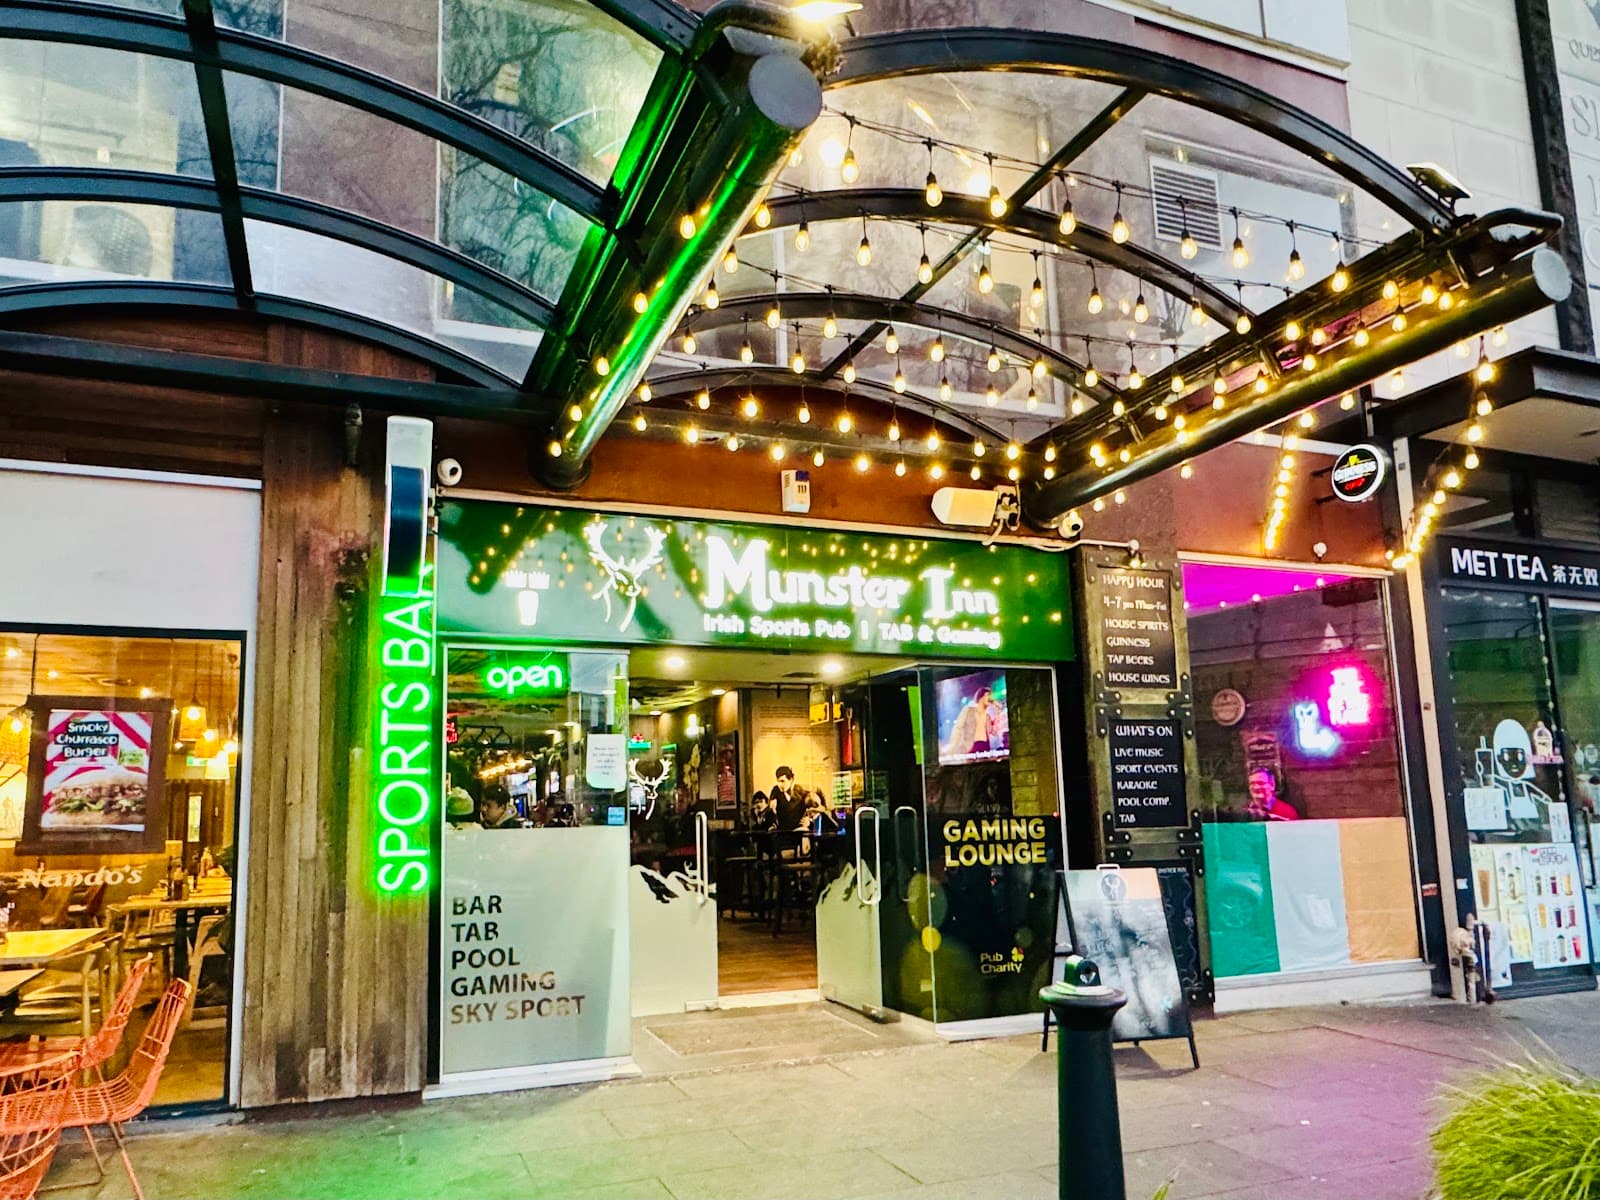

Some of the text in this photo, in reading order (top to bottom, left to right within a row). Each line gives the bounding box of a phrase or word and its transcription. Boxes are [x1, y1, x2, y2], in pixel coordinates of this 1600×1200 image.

[1450, 547, 1549, 582] MET TEA
[700, 535, 998, 619] Munster Inn
[1102, 574, 1165, 589] HAPPY HOUR
[1105, 618, 1169, 631] HOUSE SPIRITS
[703, 614, 744, 633] Irish
[750, 616, 810, 637] Sports
[815, 620, 850, 638] Pub
[879, 622, 913, 641] TAB
[918, 625, 933, 642] &
[937, 626, 1001, 649] Gaming
[1106, 636, 1151, 647] GUINNESS
[1107, 654, 1154, 666] TAP BEERS
[487, 665, 563, 694] open
[1108, 672, 1170, 684] HOUSE WINES
[67, 722, 109, 733] Smoky
[1115, 725, 1173, 737] WHAT'S ON
[56, 733, 118, 745] Churrasco
[64, 746, 107, 758] Burger
[1114, 748, 1164, 757] LIVE MUSIC
[1115, 764, 1178, 773] SPORT EVENTS
[378, 682, 430, 893] SPORTS
[1117, 781, 1158, 790] KARAOKE
[1118, 797, 1142, 806] POOL
[1119, 814, 1136, 823] TAB
[943, 818, 1046, 843] GAMING
[944, 842, 1048, 868] LOUNGE
[17, 864, 143, 889] Nando's
[452, 895, 503, 916] BAR
[452, 921, 499, 943] TAB
[451, 947, 520, 970] POOL
[980, 952, 1003, 963] Pub
[980, 962, 1022, 974] Charity
[451, 972, 556, 997] GAMING
[451, 995, 585, 1024] SKY SPORT
